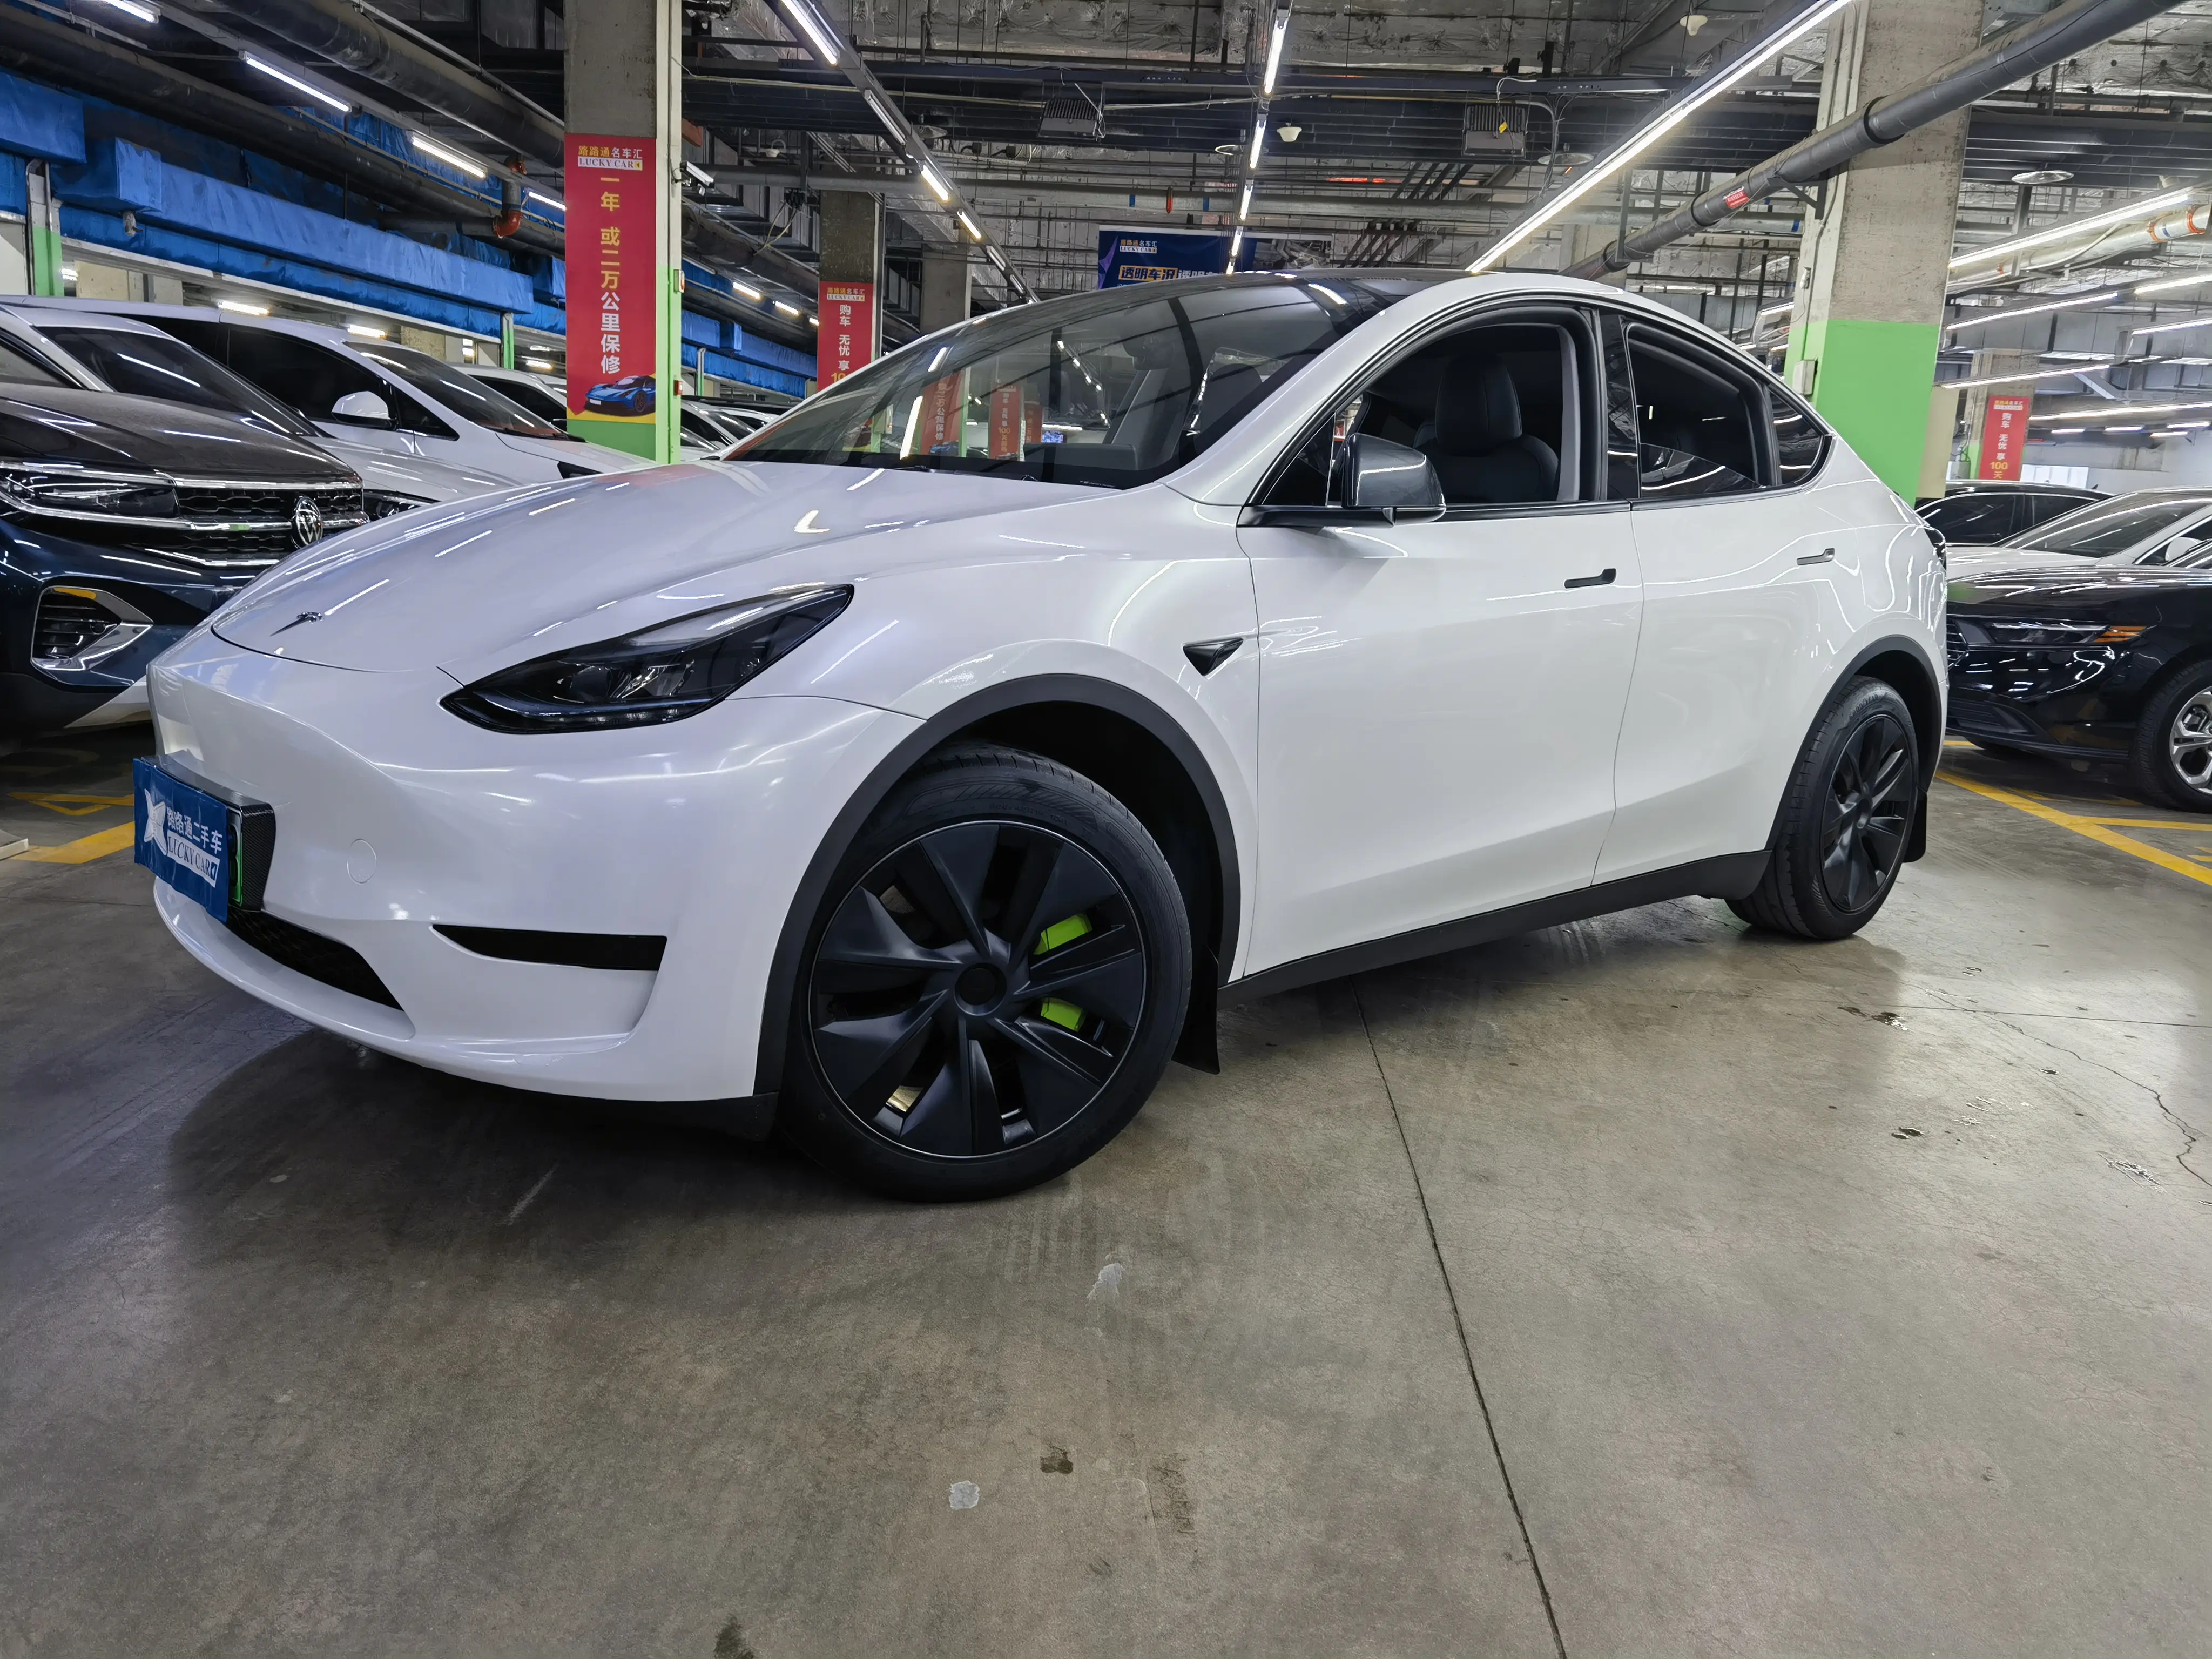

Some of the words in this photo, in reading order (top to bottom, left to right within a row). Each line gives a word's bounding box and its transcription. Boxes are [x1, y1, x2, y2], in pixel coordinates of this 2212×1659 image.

[578, 145, 643, 159] 路路通名车汇
[578, 157, 612, 167] LUCKY
[614, 159, 633, 168] CAR
[1121, 267, 1176, 280] 透明车况
[166, 806, 223, 854] 路路通二手车
[168, 835, 194, 866] LUCKY
[195, 851, 211, 877] CAR
